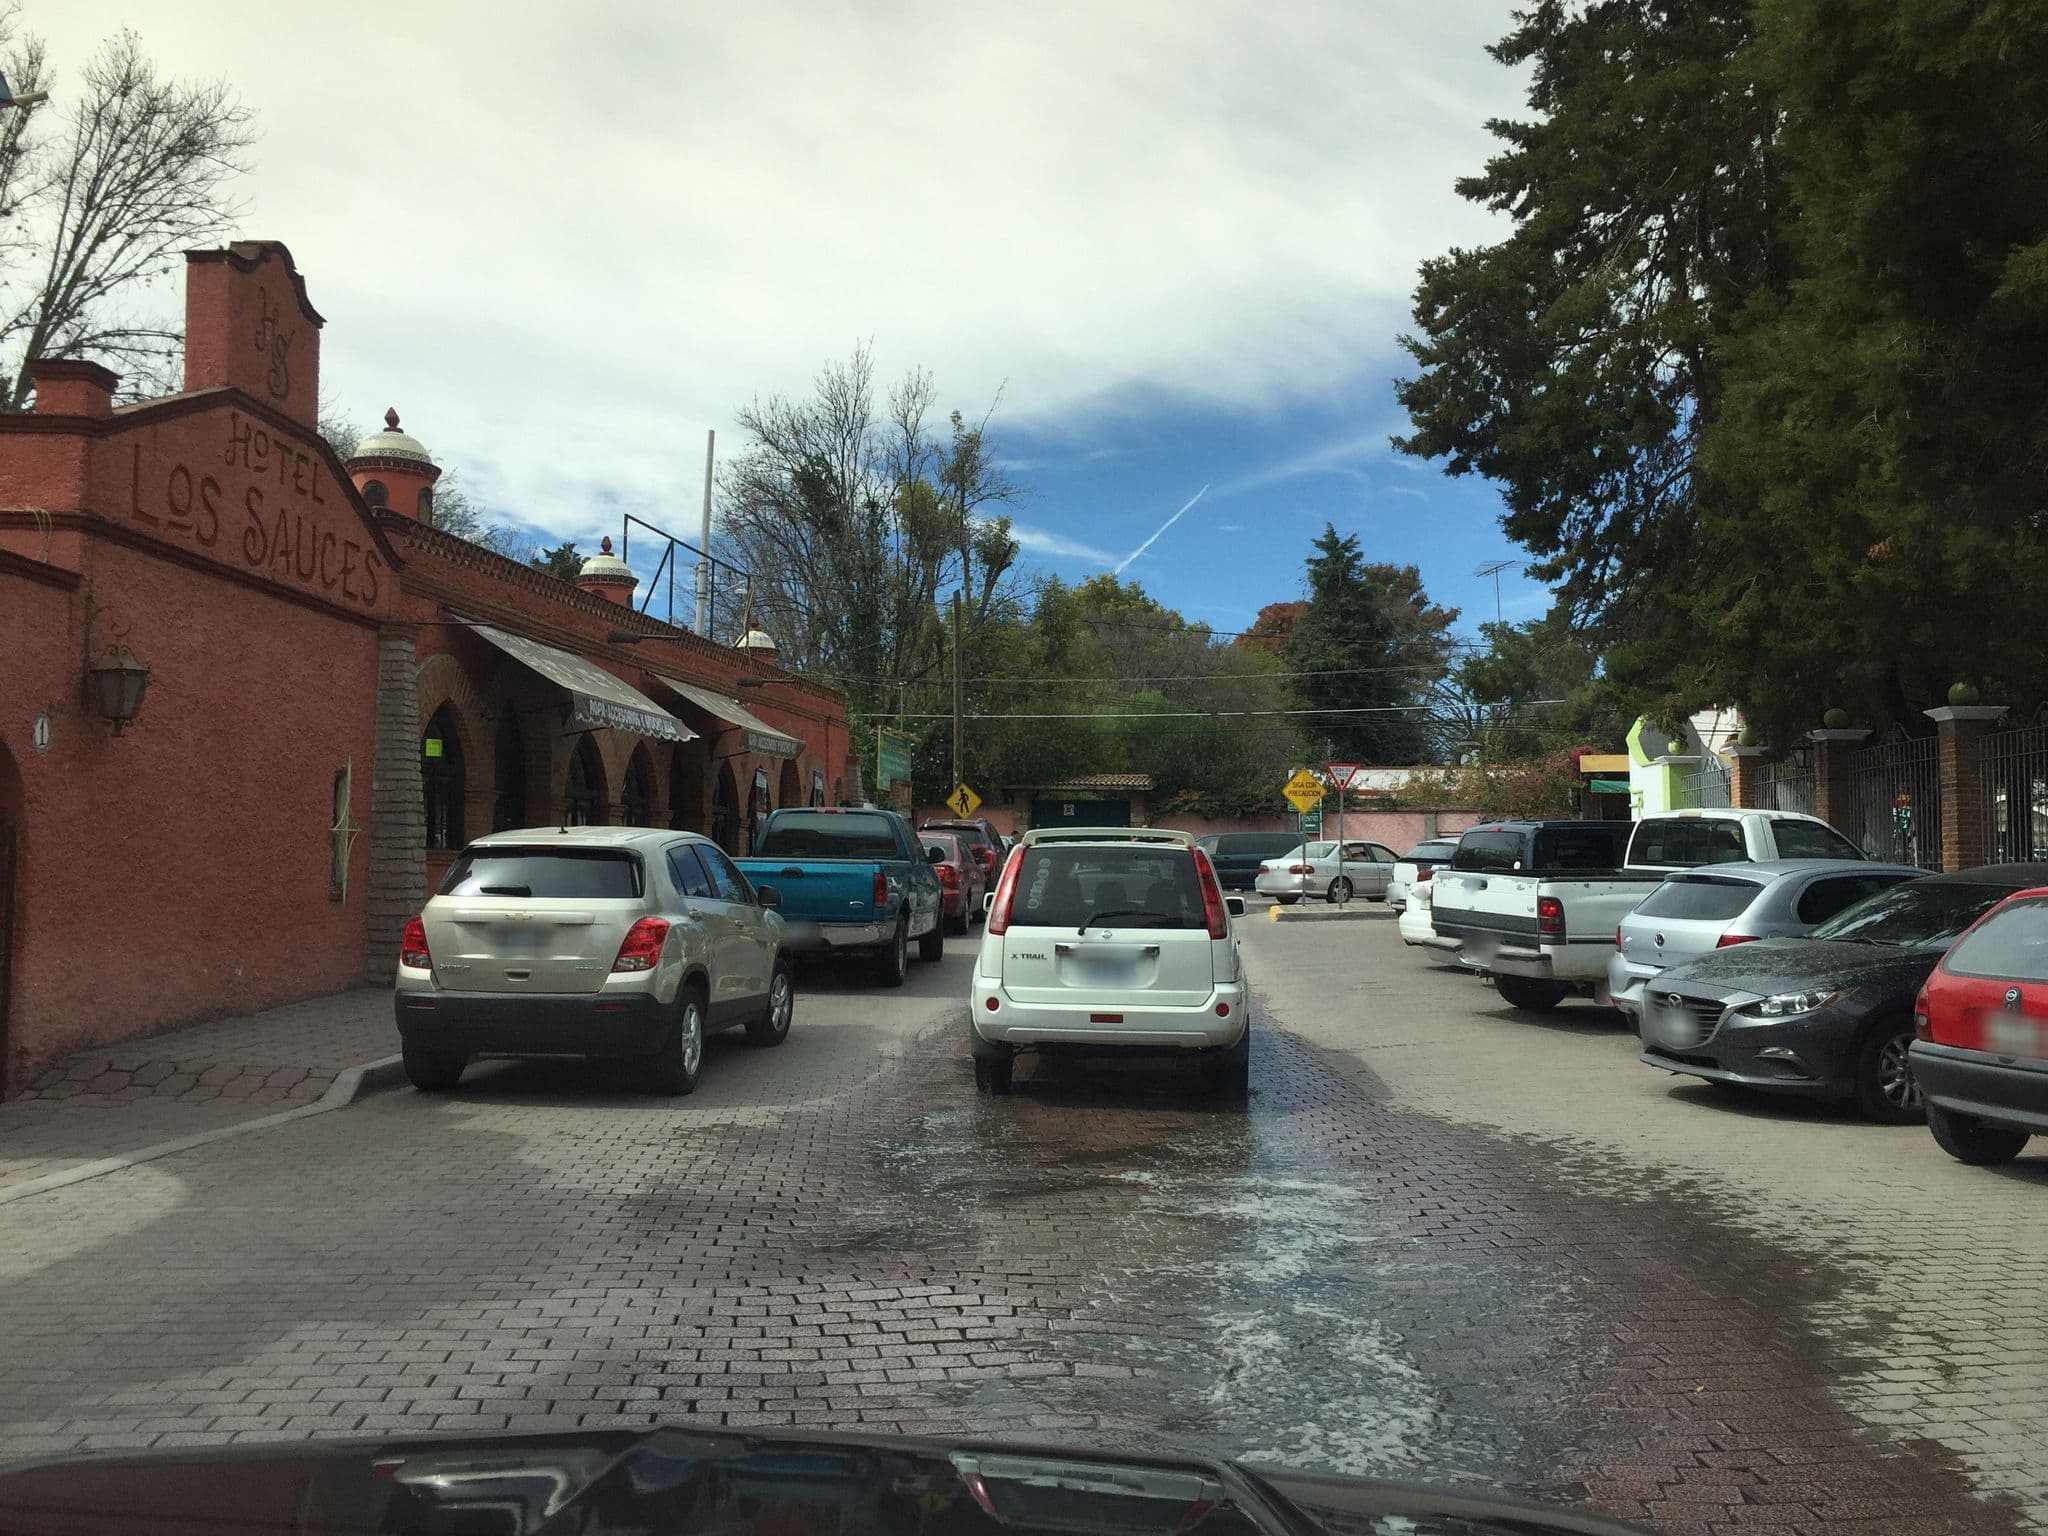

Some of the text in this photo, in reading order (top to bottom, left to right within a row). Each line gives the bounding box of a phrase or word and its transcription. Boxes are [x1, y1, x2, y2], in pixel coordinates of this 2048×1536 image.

[223, 411, 325, 506] HOTEL
[130, 443, 382, 609] LOS SAUCES
